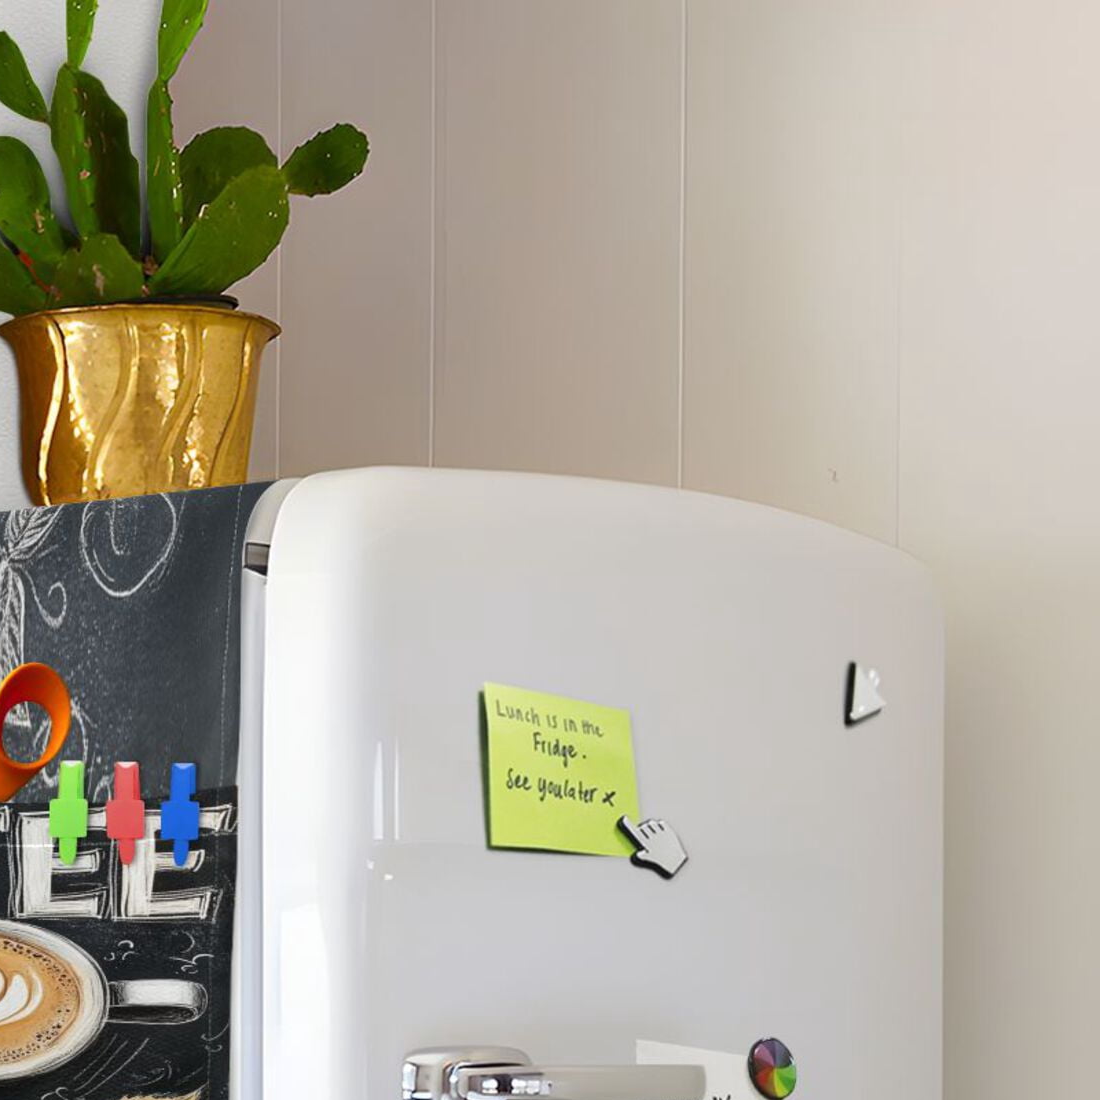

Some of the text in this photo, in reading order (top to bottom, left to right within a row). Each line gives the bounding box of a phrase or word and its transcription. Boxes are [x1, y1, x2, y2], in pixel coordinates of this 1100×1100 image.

[496, 700, 604, 738] Lunch is in the
[506, 767, 532, 791] See
